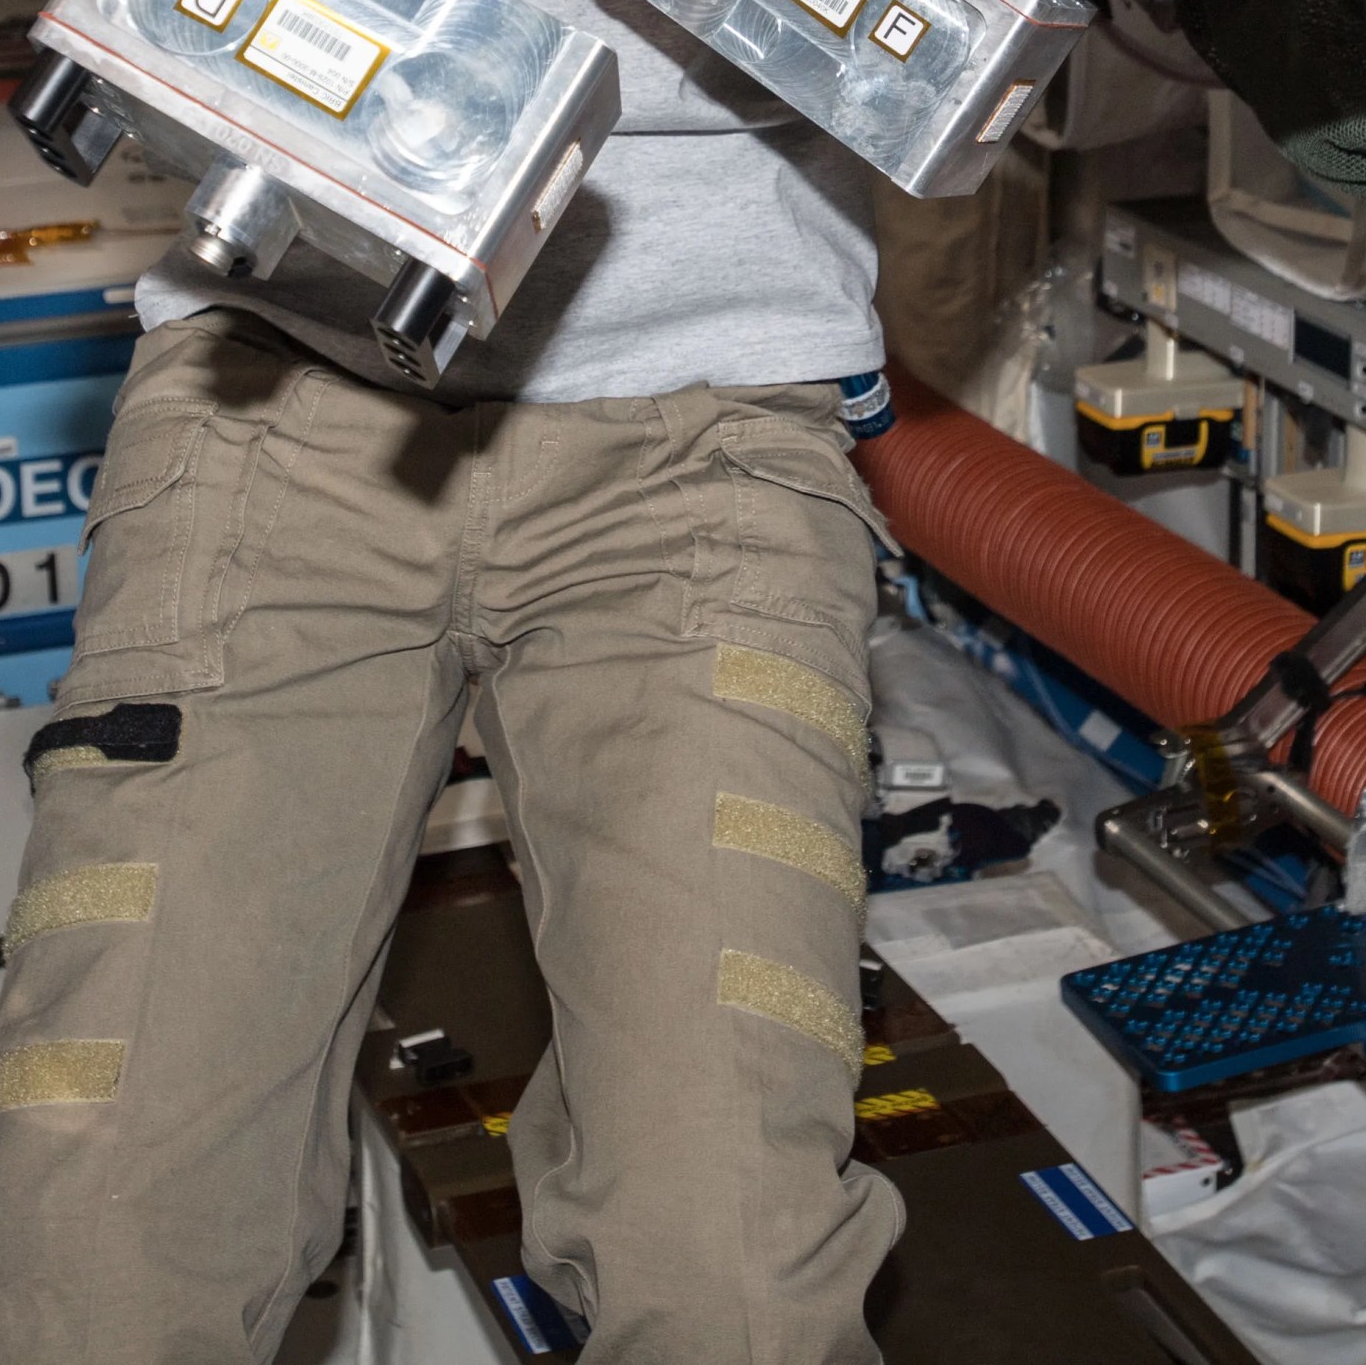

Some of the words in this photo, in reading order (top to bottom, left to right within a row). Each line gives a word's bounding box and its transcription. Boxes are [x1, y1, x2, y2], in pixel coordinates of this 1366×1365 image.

[882, 12, 916, 40] F
[285, 71, 321, 96] Canister
[33, 552, 59, 605] 1
